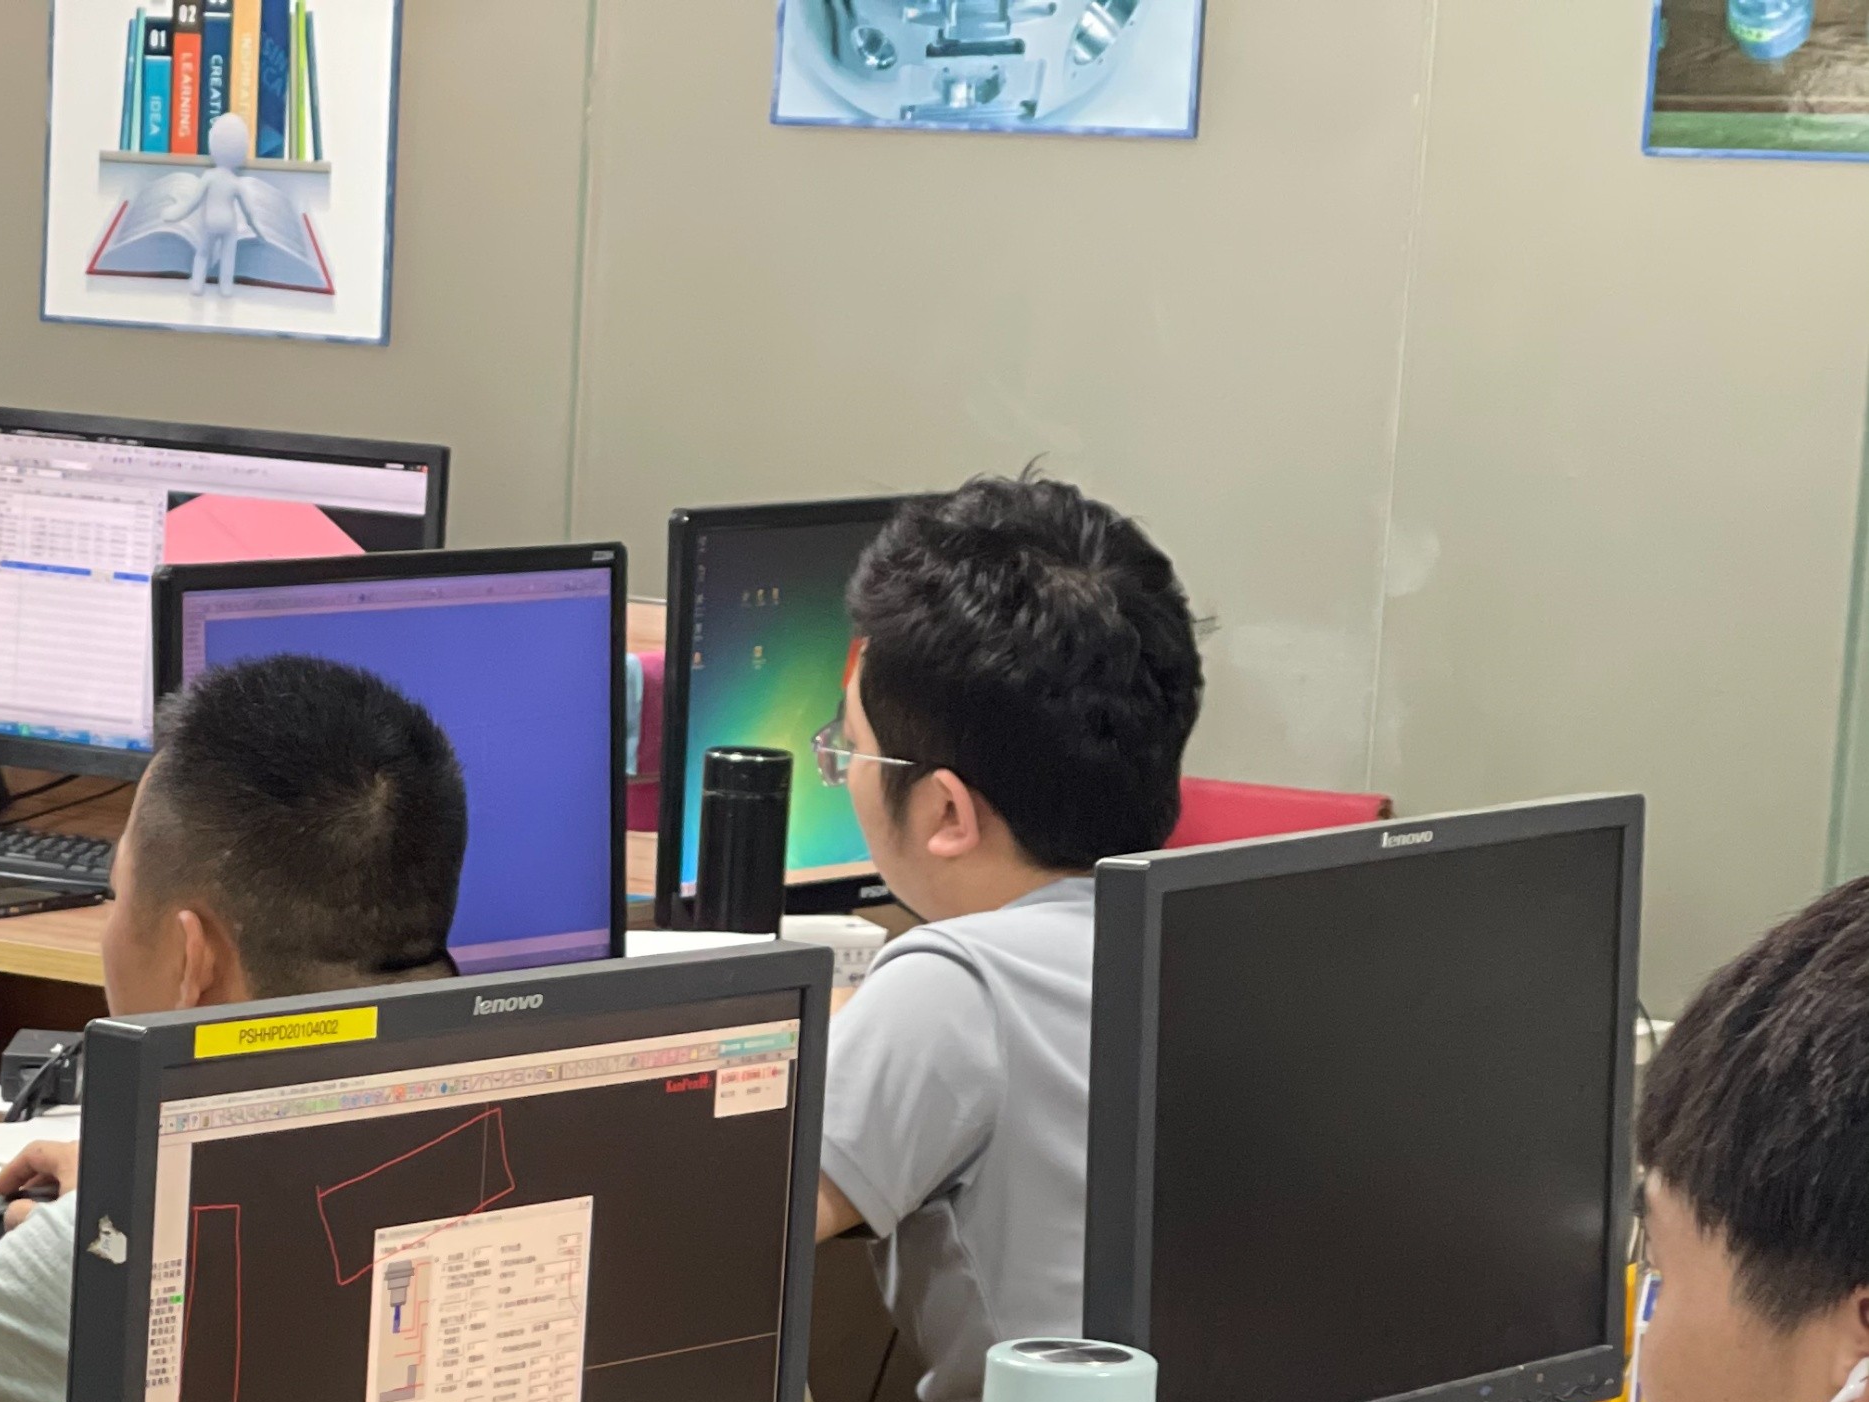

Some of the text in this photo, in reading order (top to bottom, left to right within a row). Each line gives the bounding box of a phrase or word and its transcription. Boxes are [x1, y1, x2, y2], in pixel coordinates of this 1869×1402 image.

[179, 4, 197, 23] 02
[149, 28, 167, 49] 01
[179, 52, 193, 138] LEARNING
[149, 95, 163, 136] IDEA
[1381, 830, 1434, 848] lenovo
[473, 993, 544, 1016] lenovo
[238, 1019, 339, 1045] PSHHPD20104002
